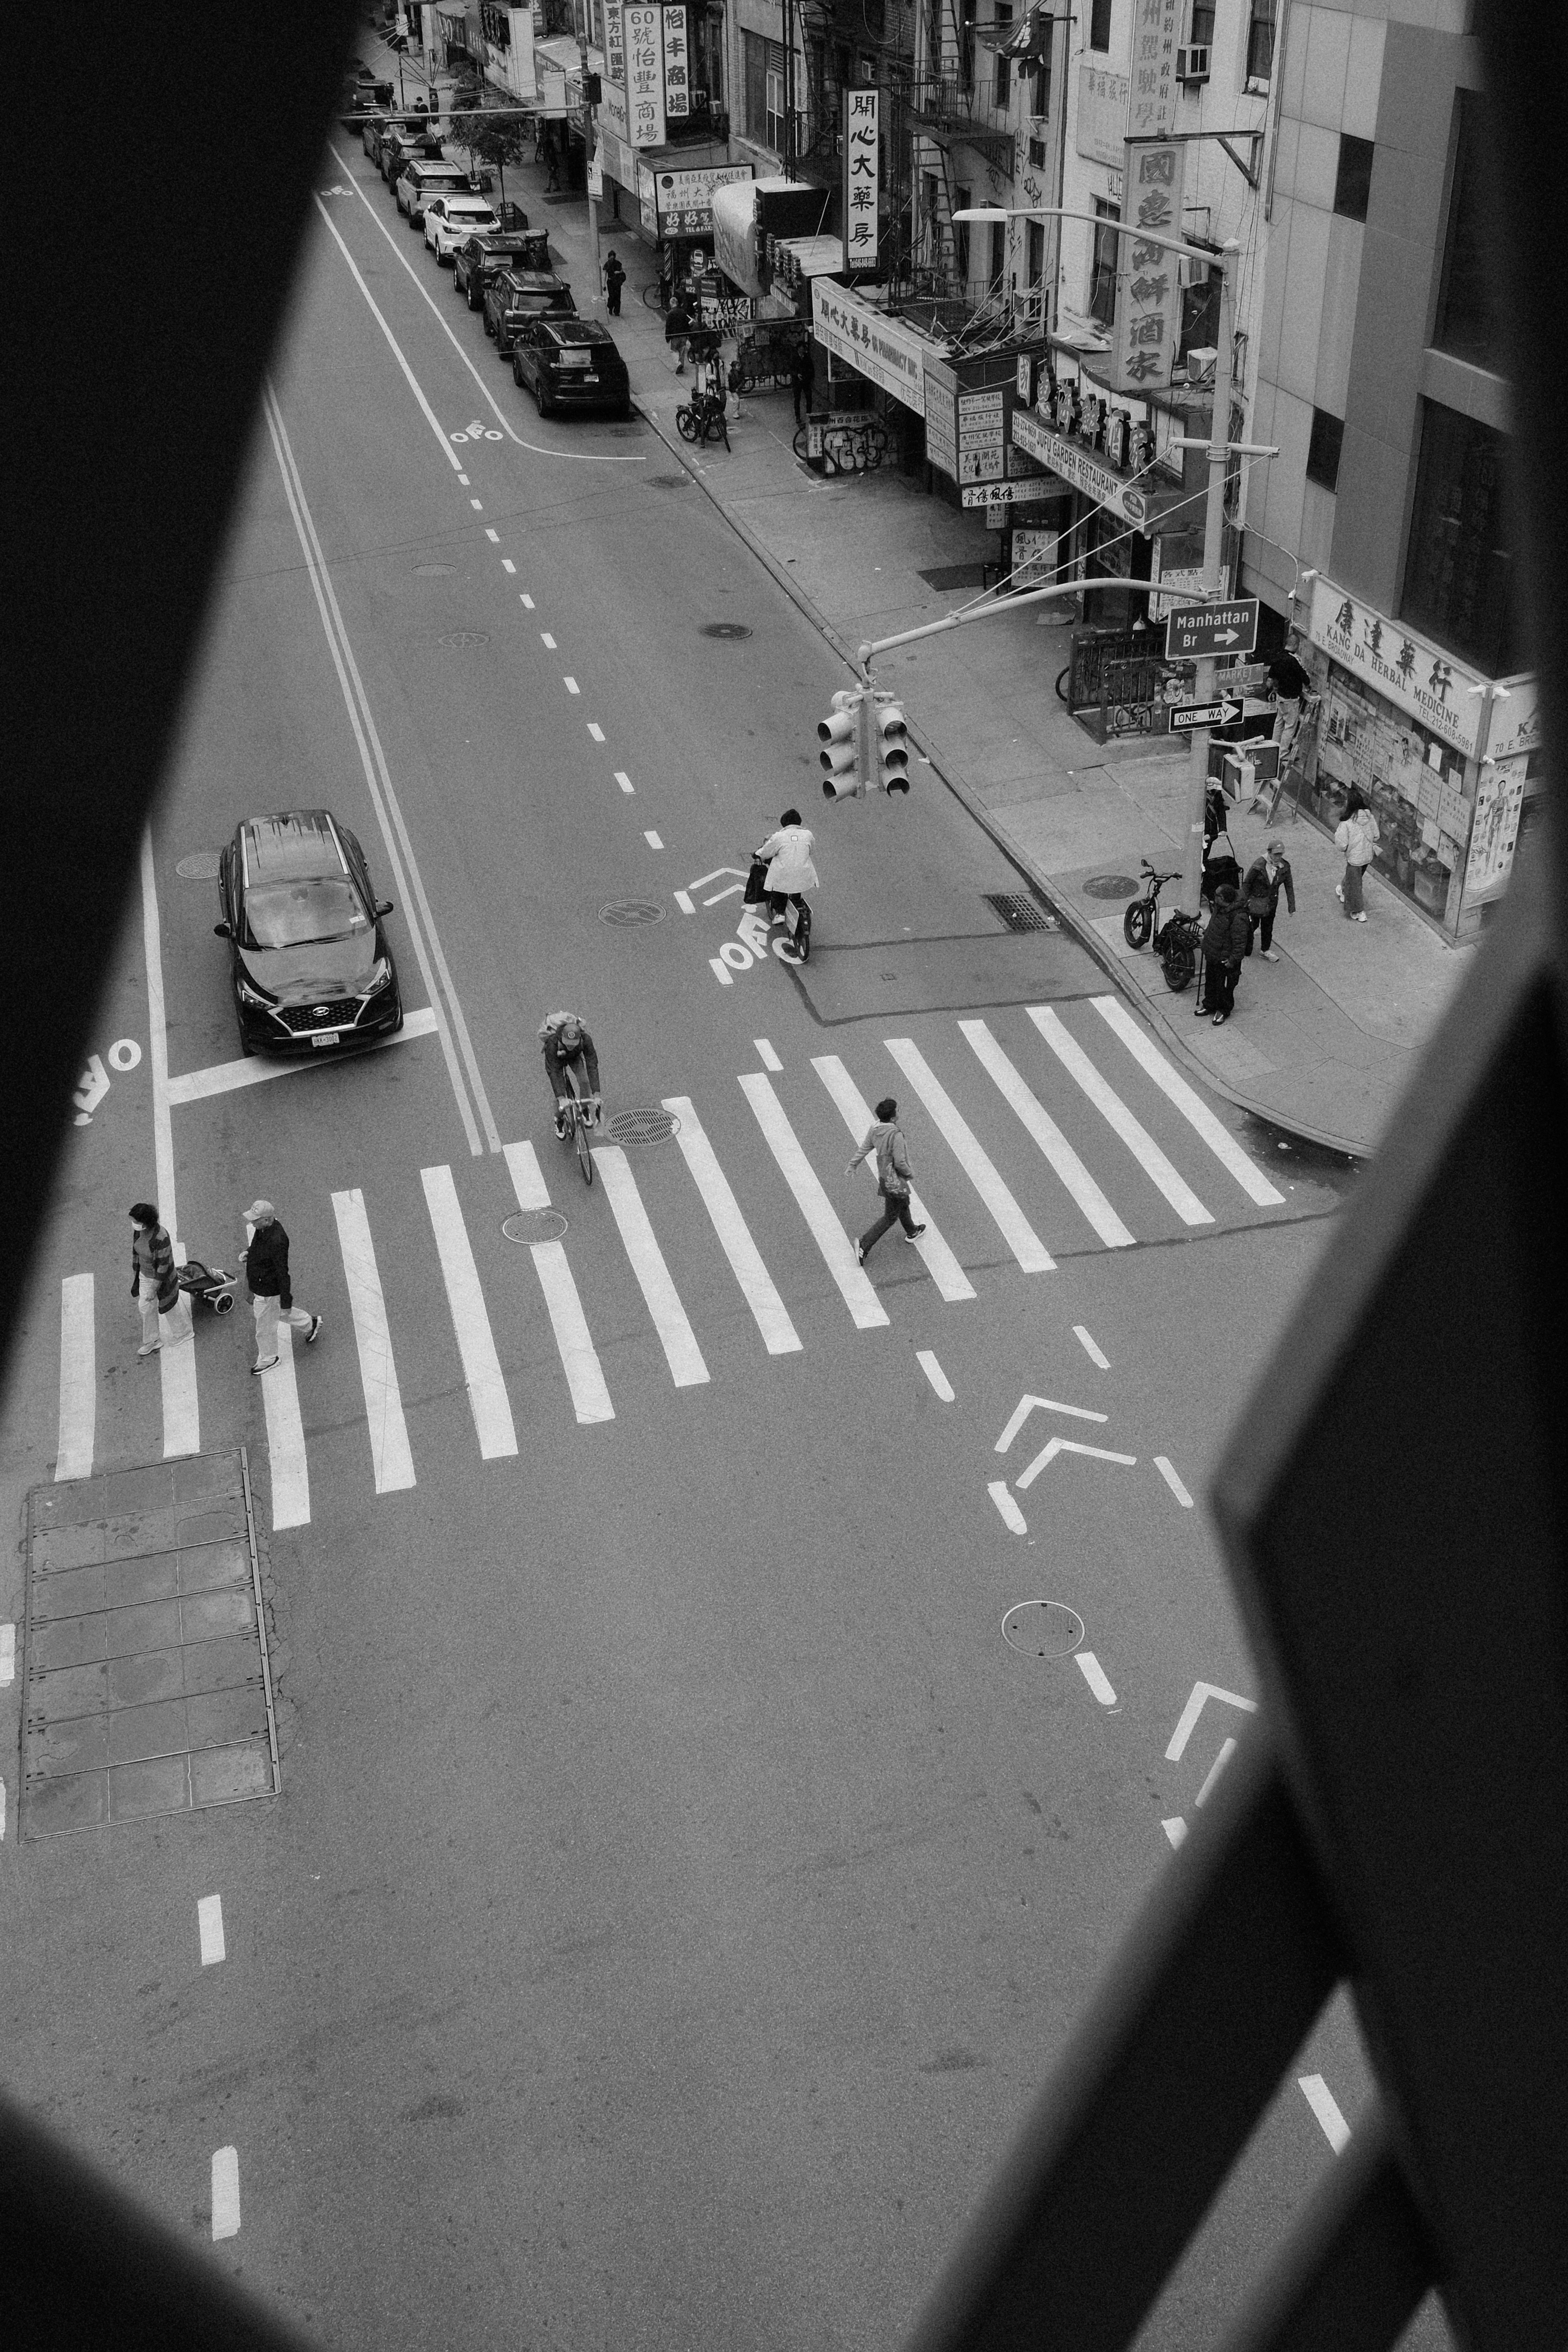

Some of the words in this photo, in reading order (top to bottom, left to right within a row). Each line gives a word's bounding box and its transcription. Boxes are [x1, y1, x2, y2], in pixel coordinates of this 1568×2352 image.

[605, 0, 625, 80] 東方紅匯款
[849, 96, 876, 247] 開心大藥房
[1037, 432, 1051, 453] JUFU
[1053, 441, 1076, 471] GARDEN
[1078, 458, 1118, 498] RESTAURANT
[1177, 611, 1249, 629] Manhattan
[1183, 634, 1197, 647] Br
[1315, 631, 1321, 642] 70
[1328, 640, 1355, 666] BROADWAY
[1335, 599, 1454, 703] 康達藥行
[1219, 667, 1253, 682] MARKET
[1326, 624, 1351, 651] KANG
[1354, 642, 1365, 663] DA
[1370, 656, 1407, 692] HERBAL
[1413, 686, 1460, 729] MEDICINE
[1178, 712, 1198, 723] ONE
[1208, 707, 1230, 719] WAY
[1496, 743, 1504, 753] 70
